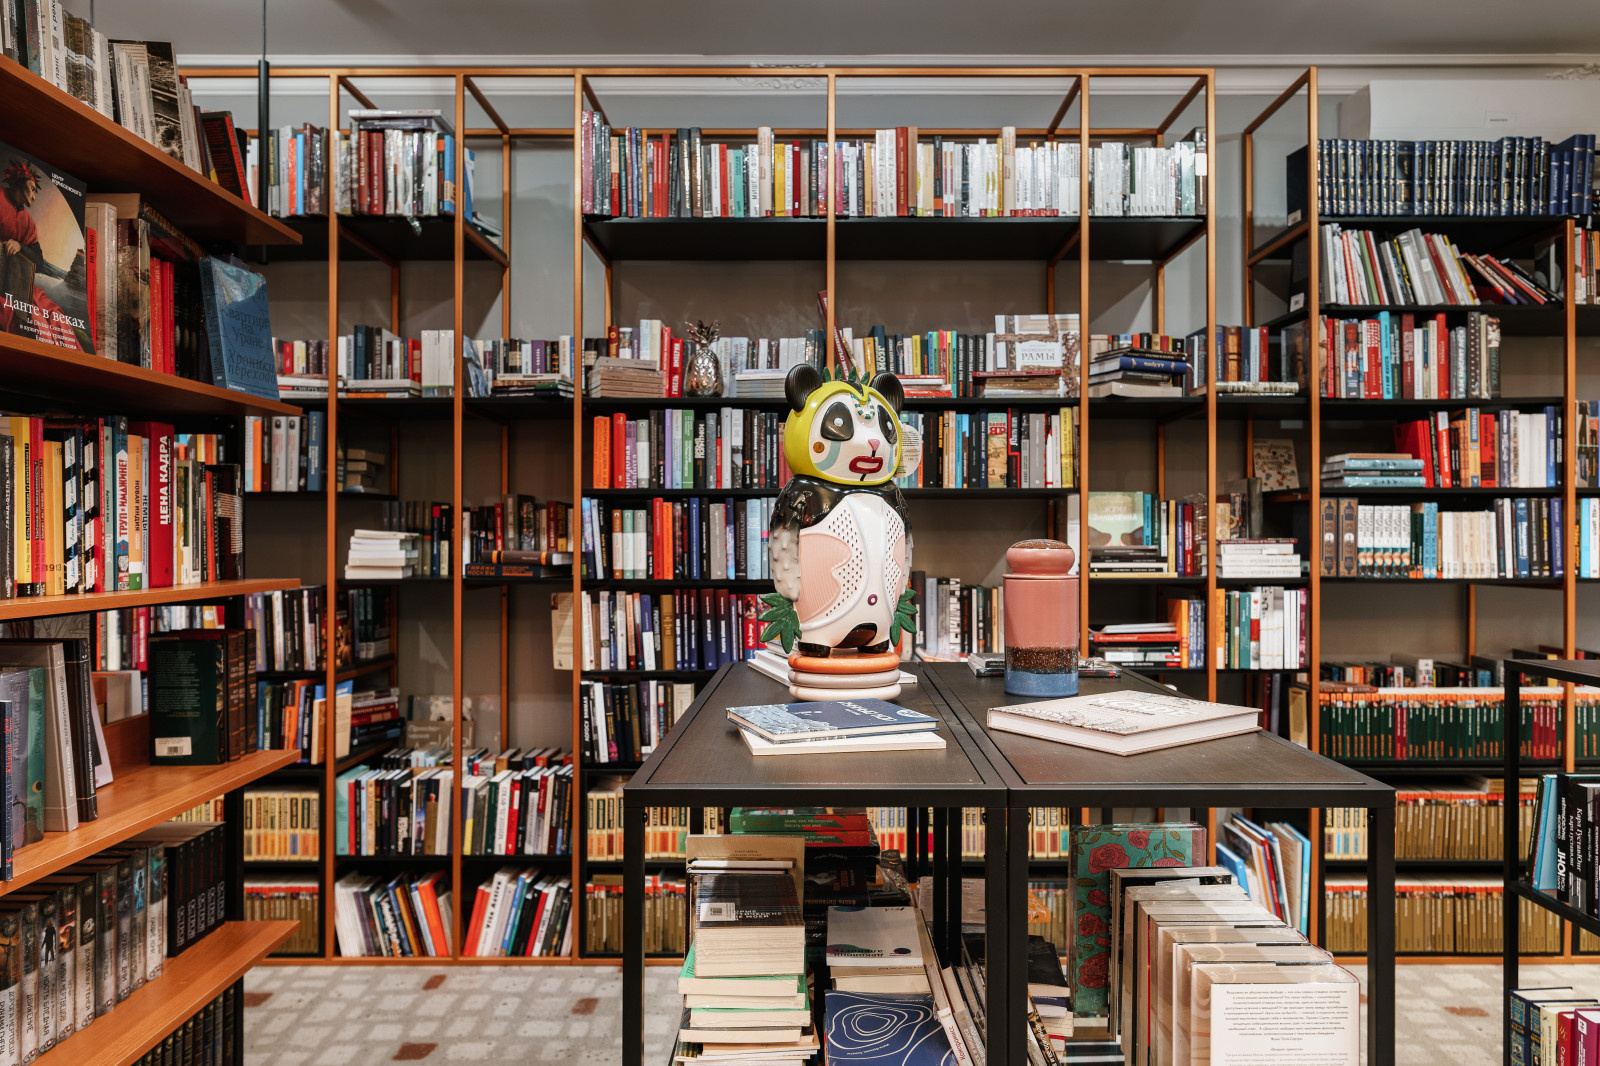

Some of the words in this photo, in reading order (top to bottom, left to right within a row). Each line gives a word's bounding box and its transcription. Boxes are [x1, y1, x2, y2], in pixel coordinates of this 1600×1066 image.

[3, 292, 40, 316] Данте
[42, 308, 50, 319] в
[51, 311, 86, 330] веках
[1020, 352, 1055, 362] РАМЫ
[159, 435, 170, 483] КАДРА
[118, 459, 128, 507] ИМАДЖИНЕ!
[159, 486, 170, 525] ЦЕНА
[119, 513, 128, 537] ТРУП
[1575, 808, 1583, 828] Карл
[1575, 828, 1583, 852] Густав
[1557, 848, 1566, 877] ЮНГ
[26, 994, 34, 1034] ДВИЖЕНИЕ
[948, 1025, 966, 1061] Компромисс
